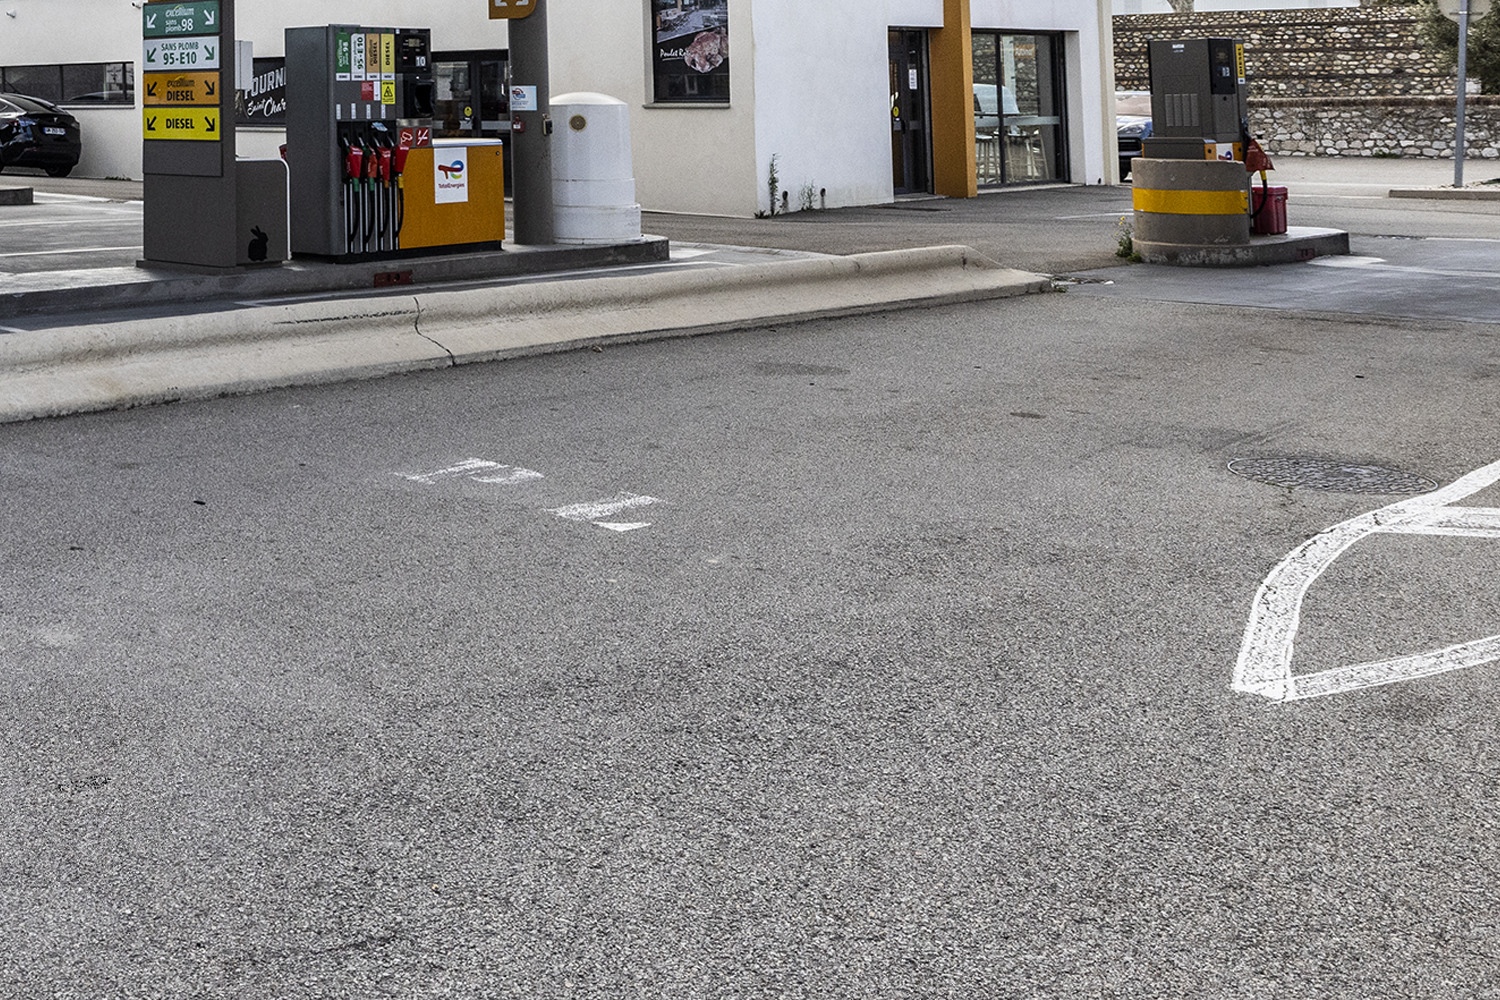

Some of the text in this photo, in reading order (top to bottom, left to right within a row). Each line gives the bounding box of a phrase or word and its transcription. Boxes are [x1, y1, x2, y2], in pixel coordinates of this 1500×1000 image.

[181, 18, 194, 32] 98
[161, 42, 199, 51] SANS PLOMB
[163, 52, 197, 65] 95-E10
[416, 56, 426, 67] 10
[166, 90, 195, 101] DIESEL
[165, 118, 195, 129] DIESEL
